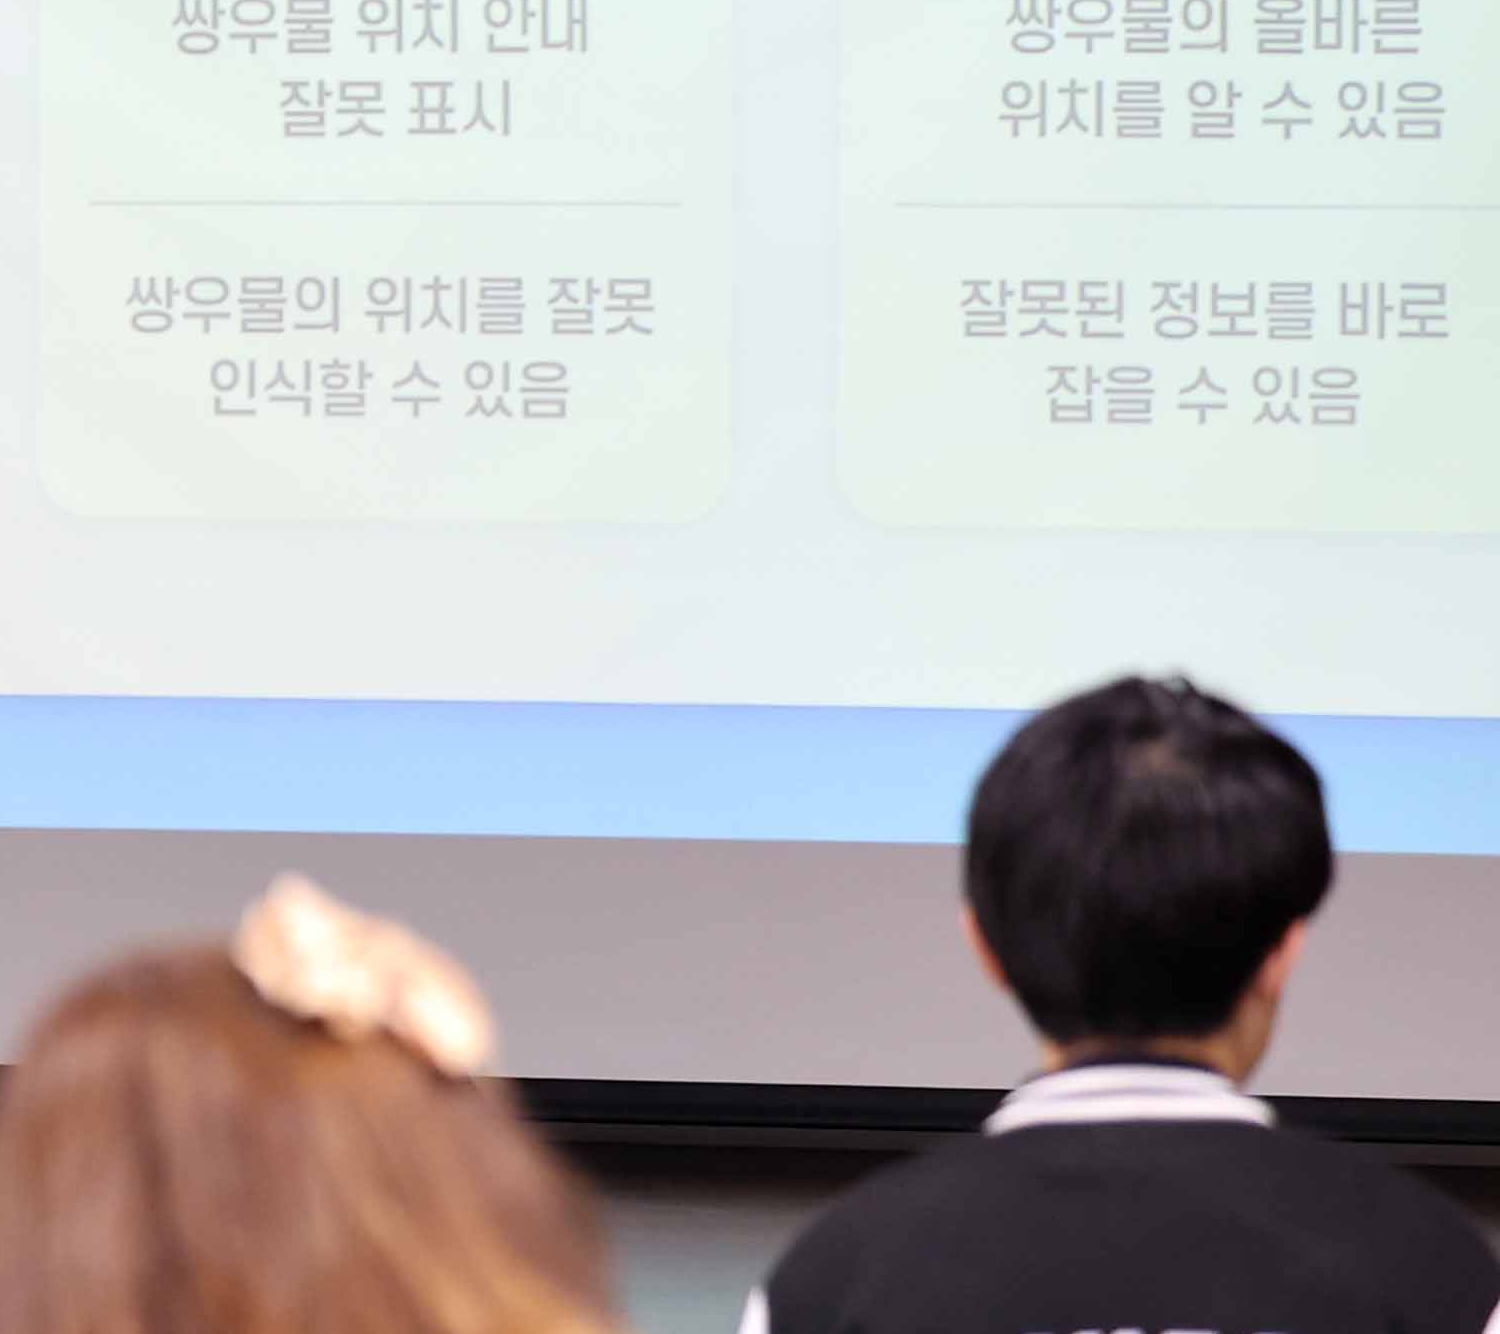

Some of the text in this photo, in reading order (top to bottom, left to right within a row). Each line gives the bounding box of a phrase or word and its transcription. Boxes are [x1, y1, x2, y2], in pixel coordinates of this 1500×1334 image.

[279, 79, 511, 138] 잘못 표시
[997, 78, 1446, 141] 위치를 알 수 있음
[125, 274, 655, 336] 쌍우물의 위치를 잘못
[960, 279, 1450, 341] 잘못된 정보를 바로
[209, 357, 570, 419] 인식할 수 있음
[1045, 364, 1361, 427] 잡을 수 있음
